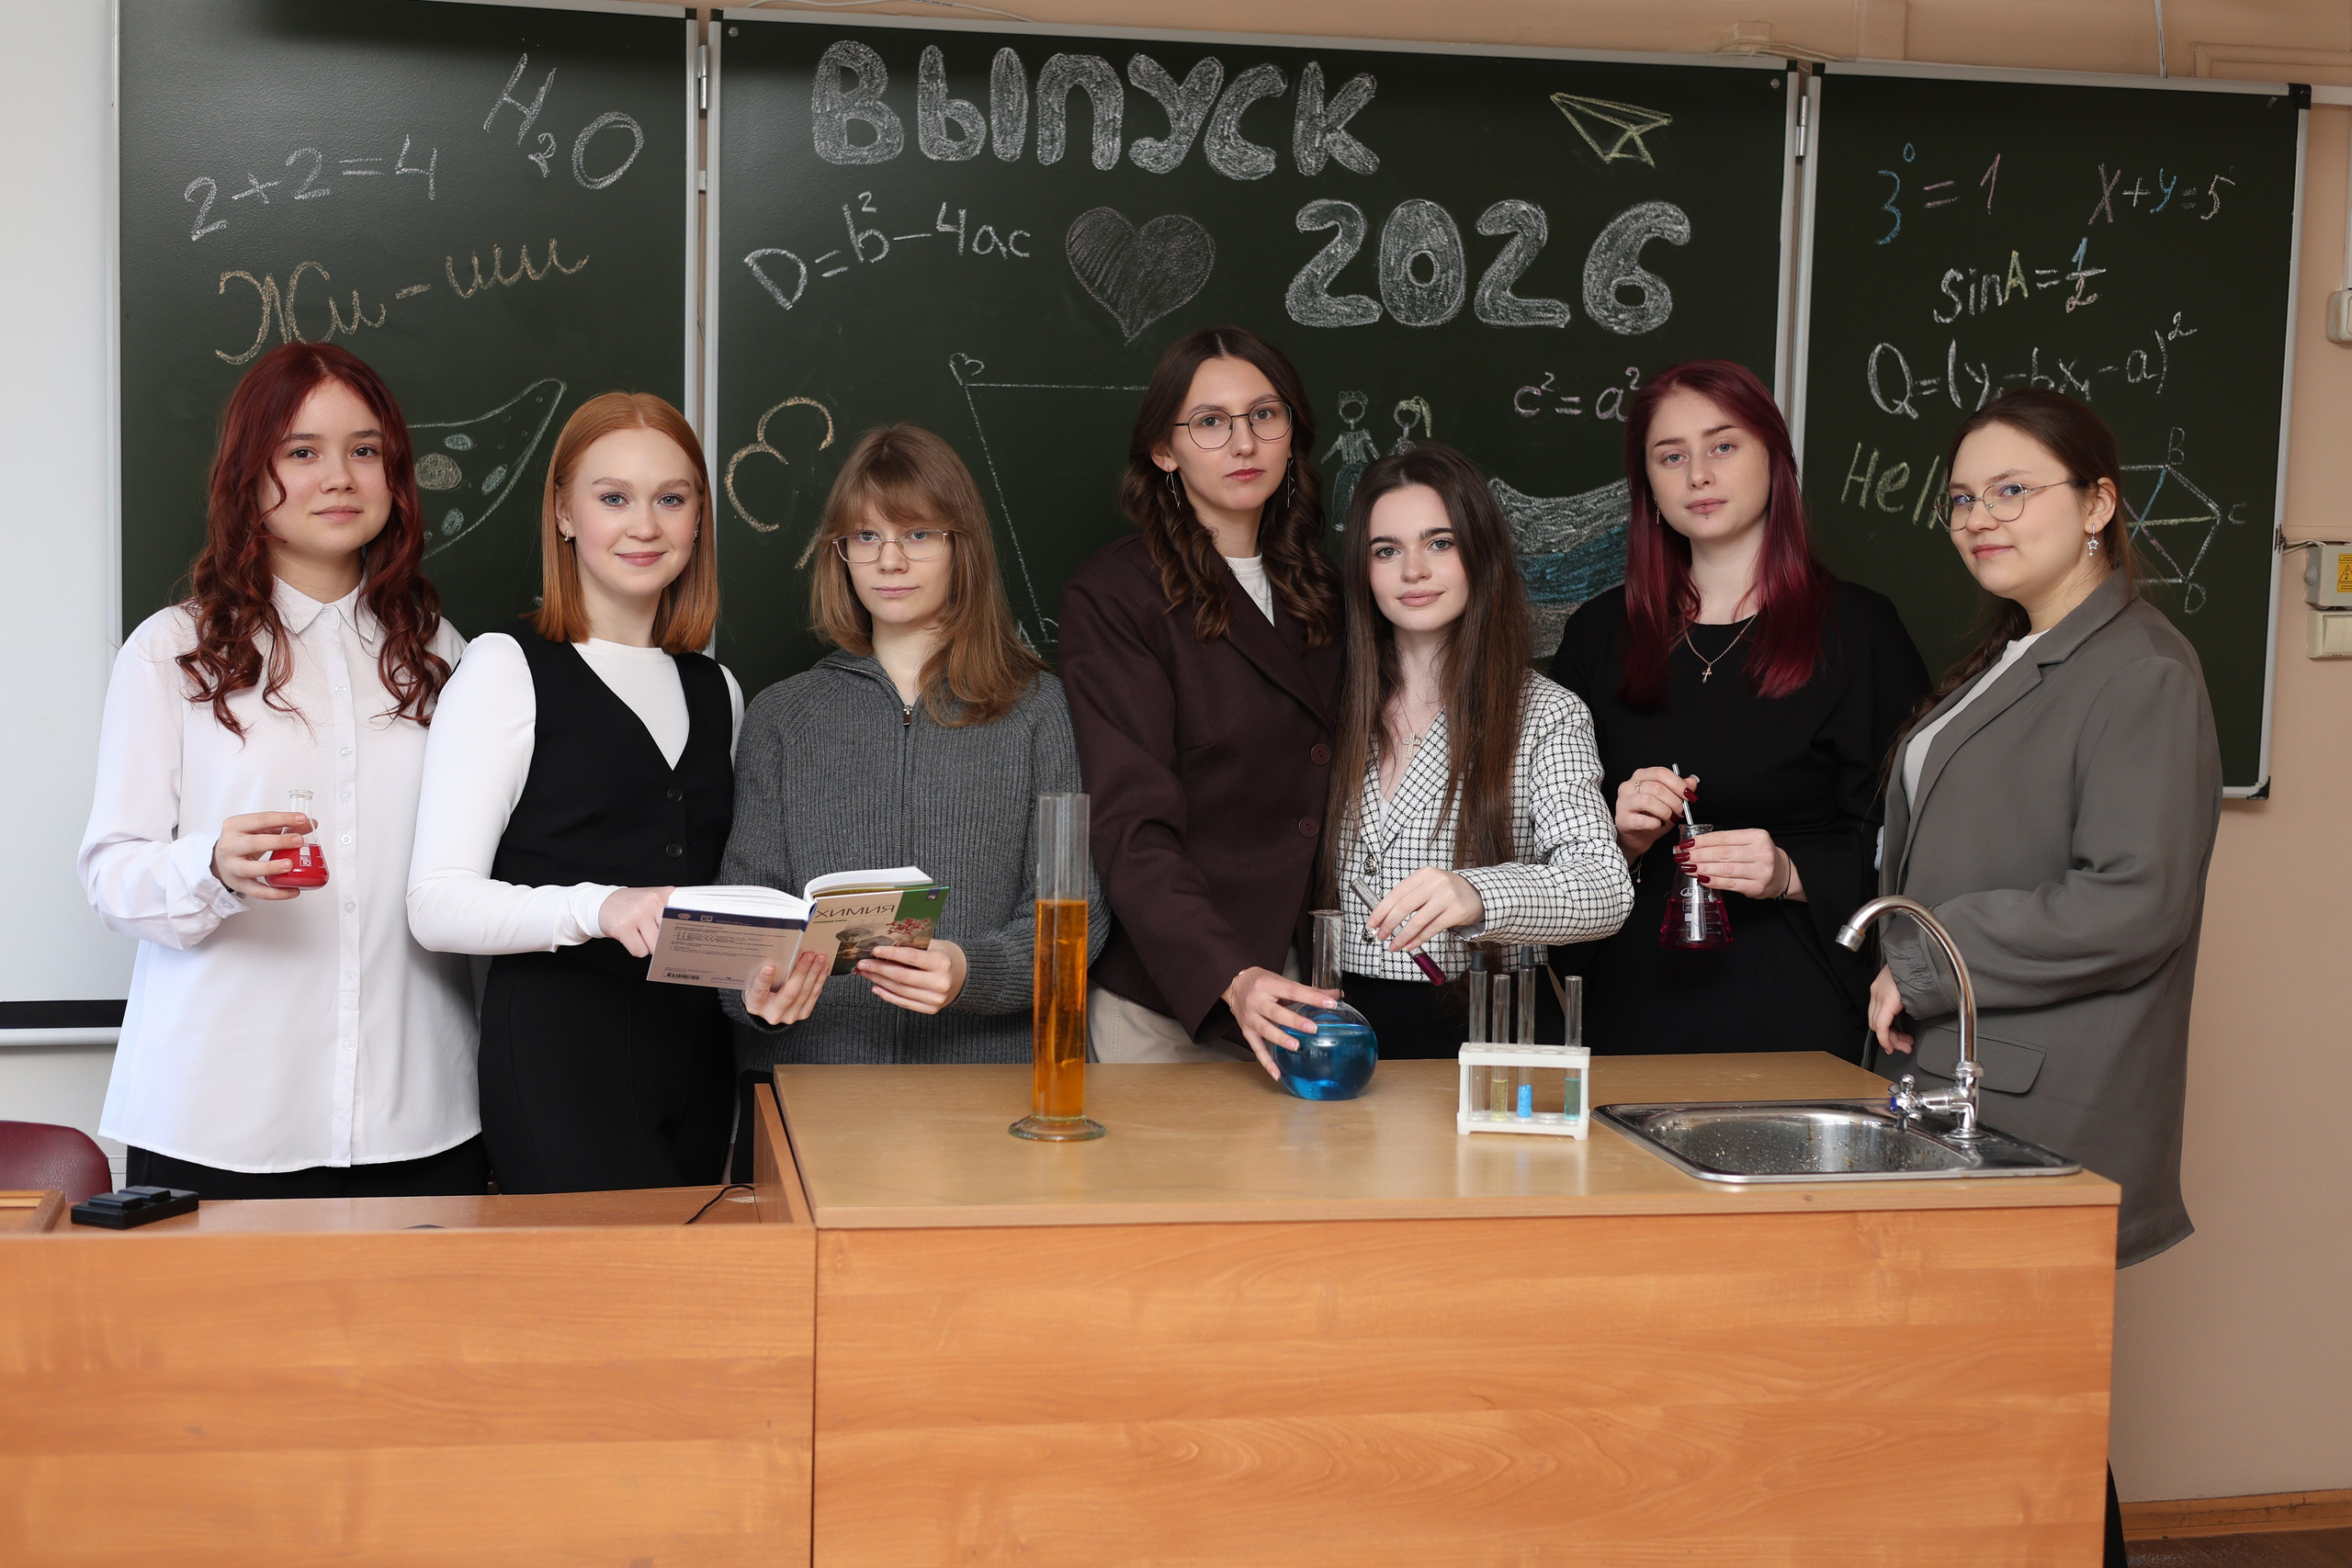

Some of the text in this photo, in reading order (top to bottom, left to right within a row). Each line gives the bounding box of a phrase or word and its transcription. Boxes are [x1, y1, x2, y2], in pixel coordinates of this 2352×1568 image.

[811, 39, 1380, 181] ВЫПУСК
[1285, 198, 1691, 335] 2026
[2167, 426, 2186, 465] B
[814, 904, 896, 919] ХИМИЯ
